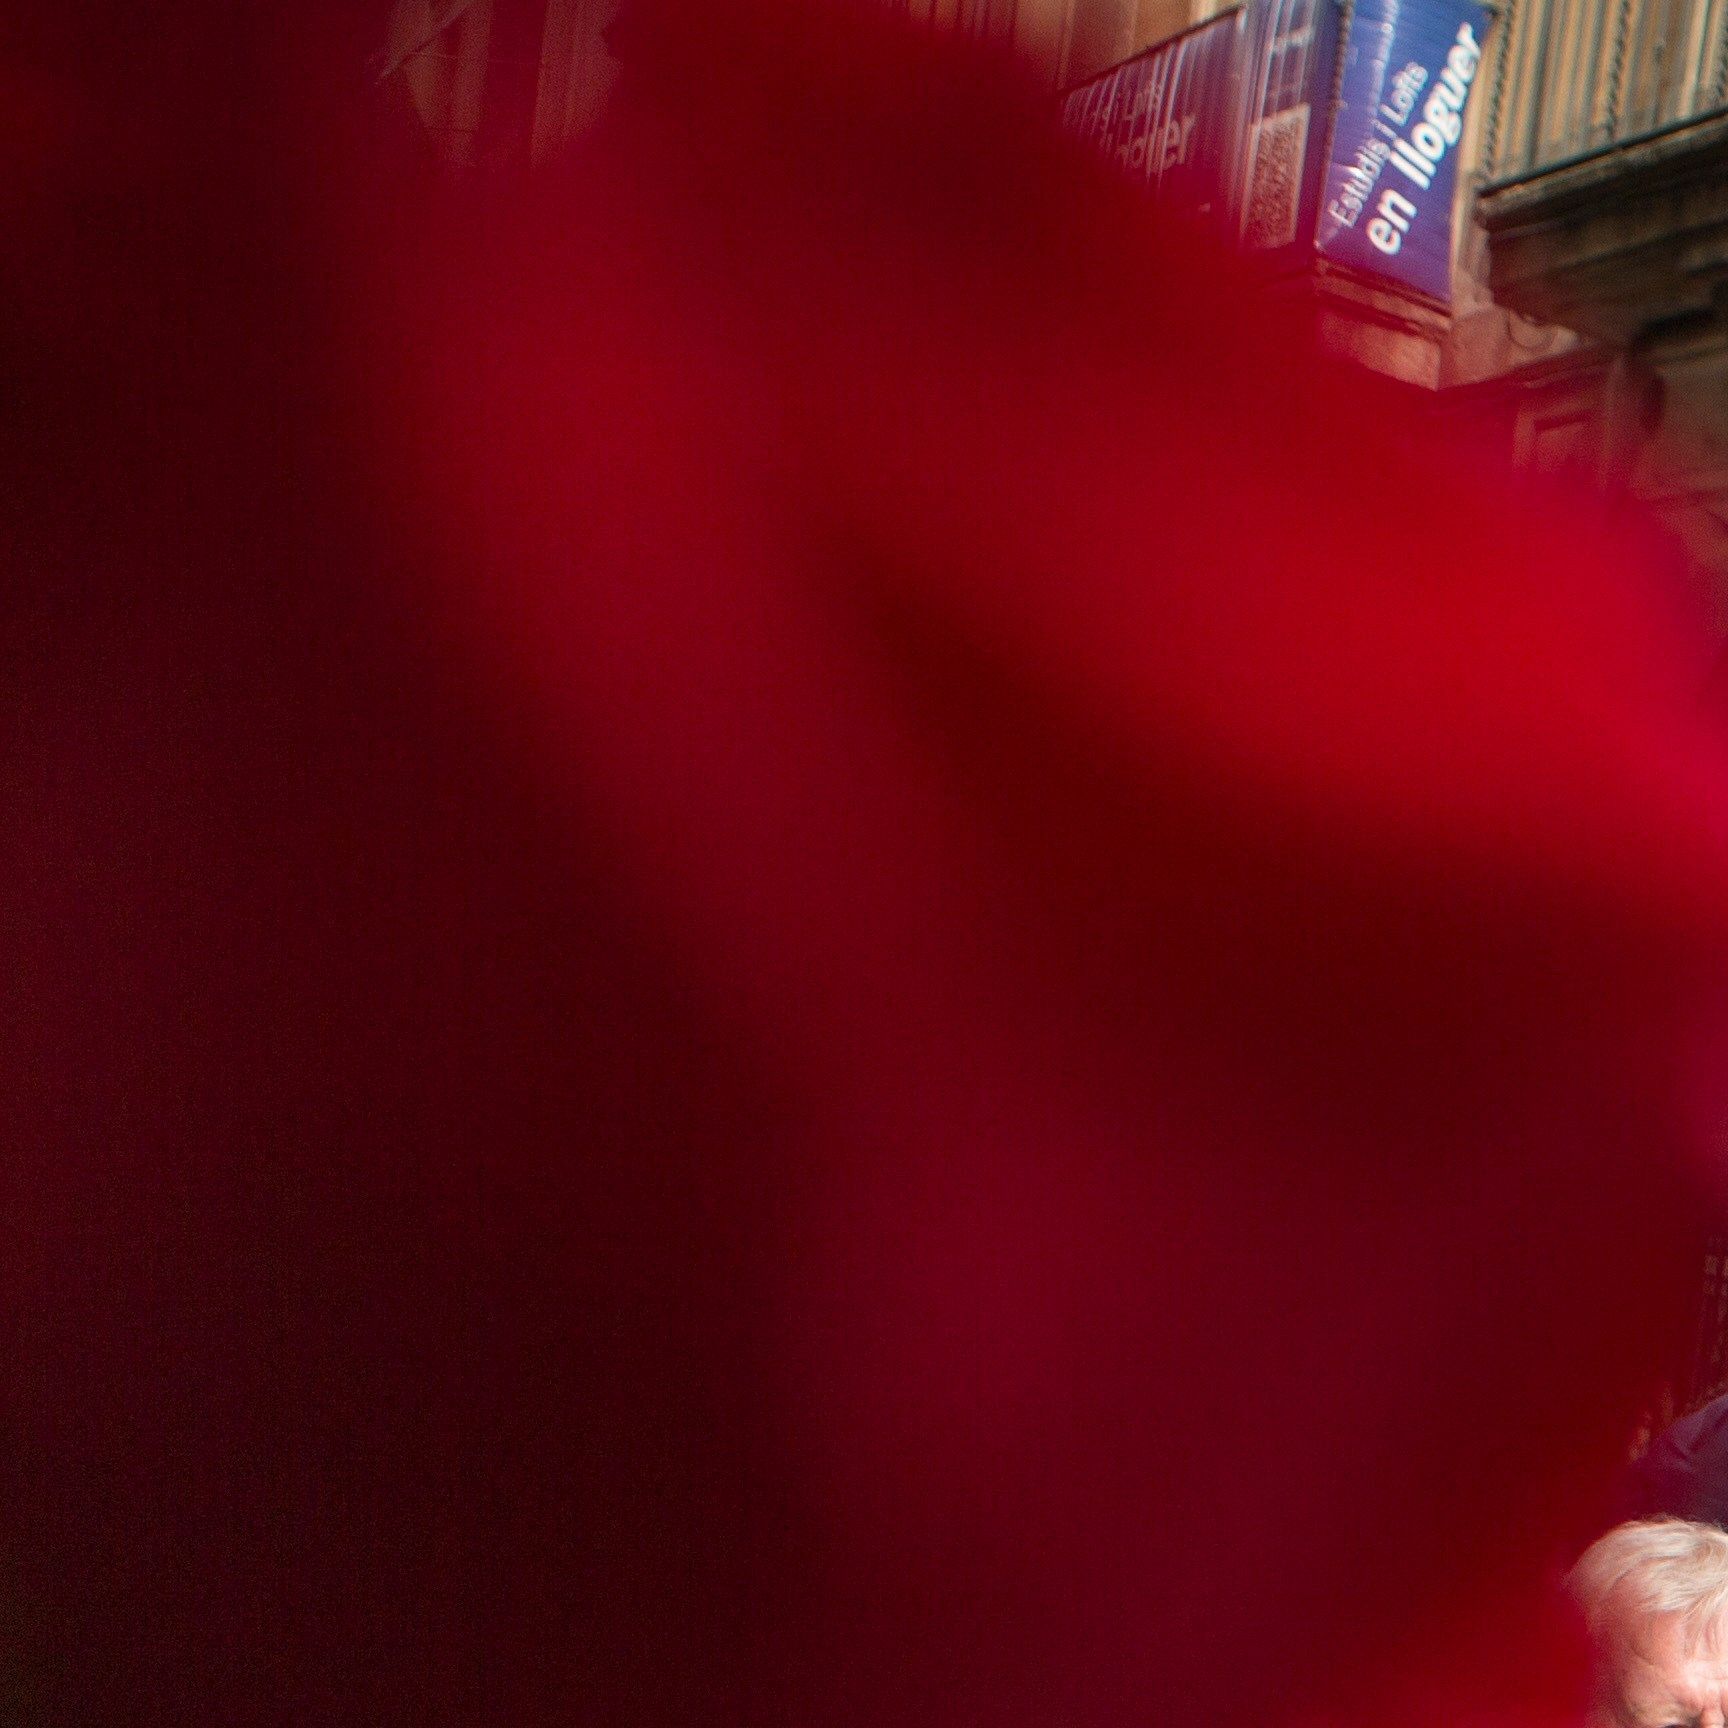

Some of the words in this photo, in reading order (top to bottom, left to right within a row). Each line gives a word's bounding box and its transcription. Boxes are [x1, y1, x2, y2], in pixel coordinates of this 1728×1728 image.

[1378, 61, 1429, 127] Lofts
[1389, 21, 1481, 190] lloguer
[1366, 188, 1418, 255] en
